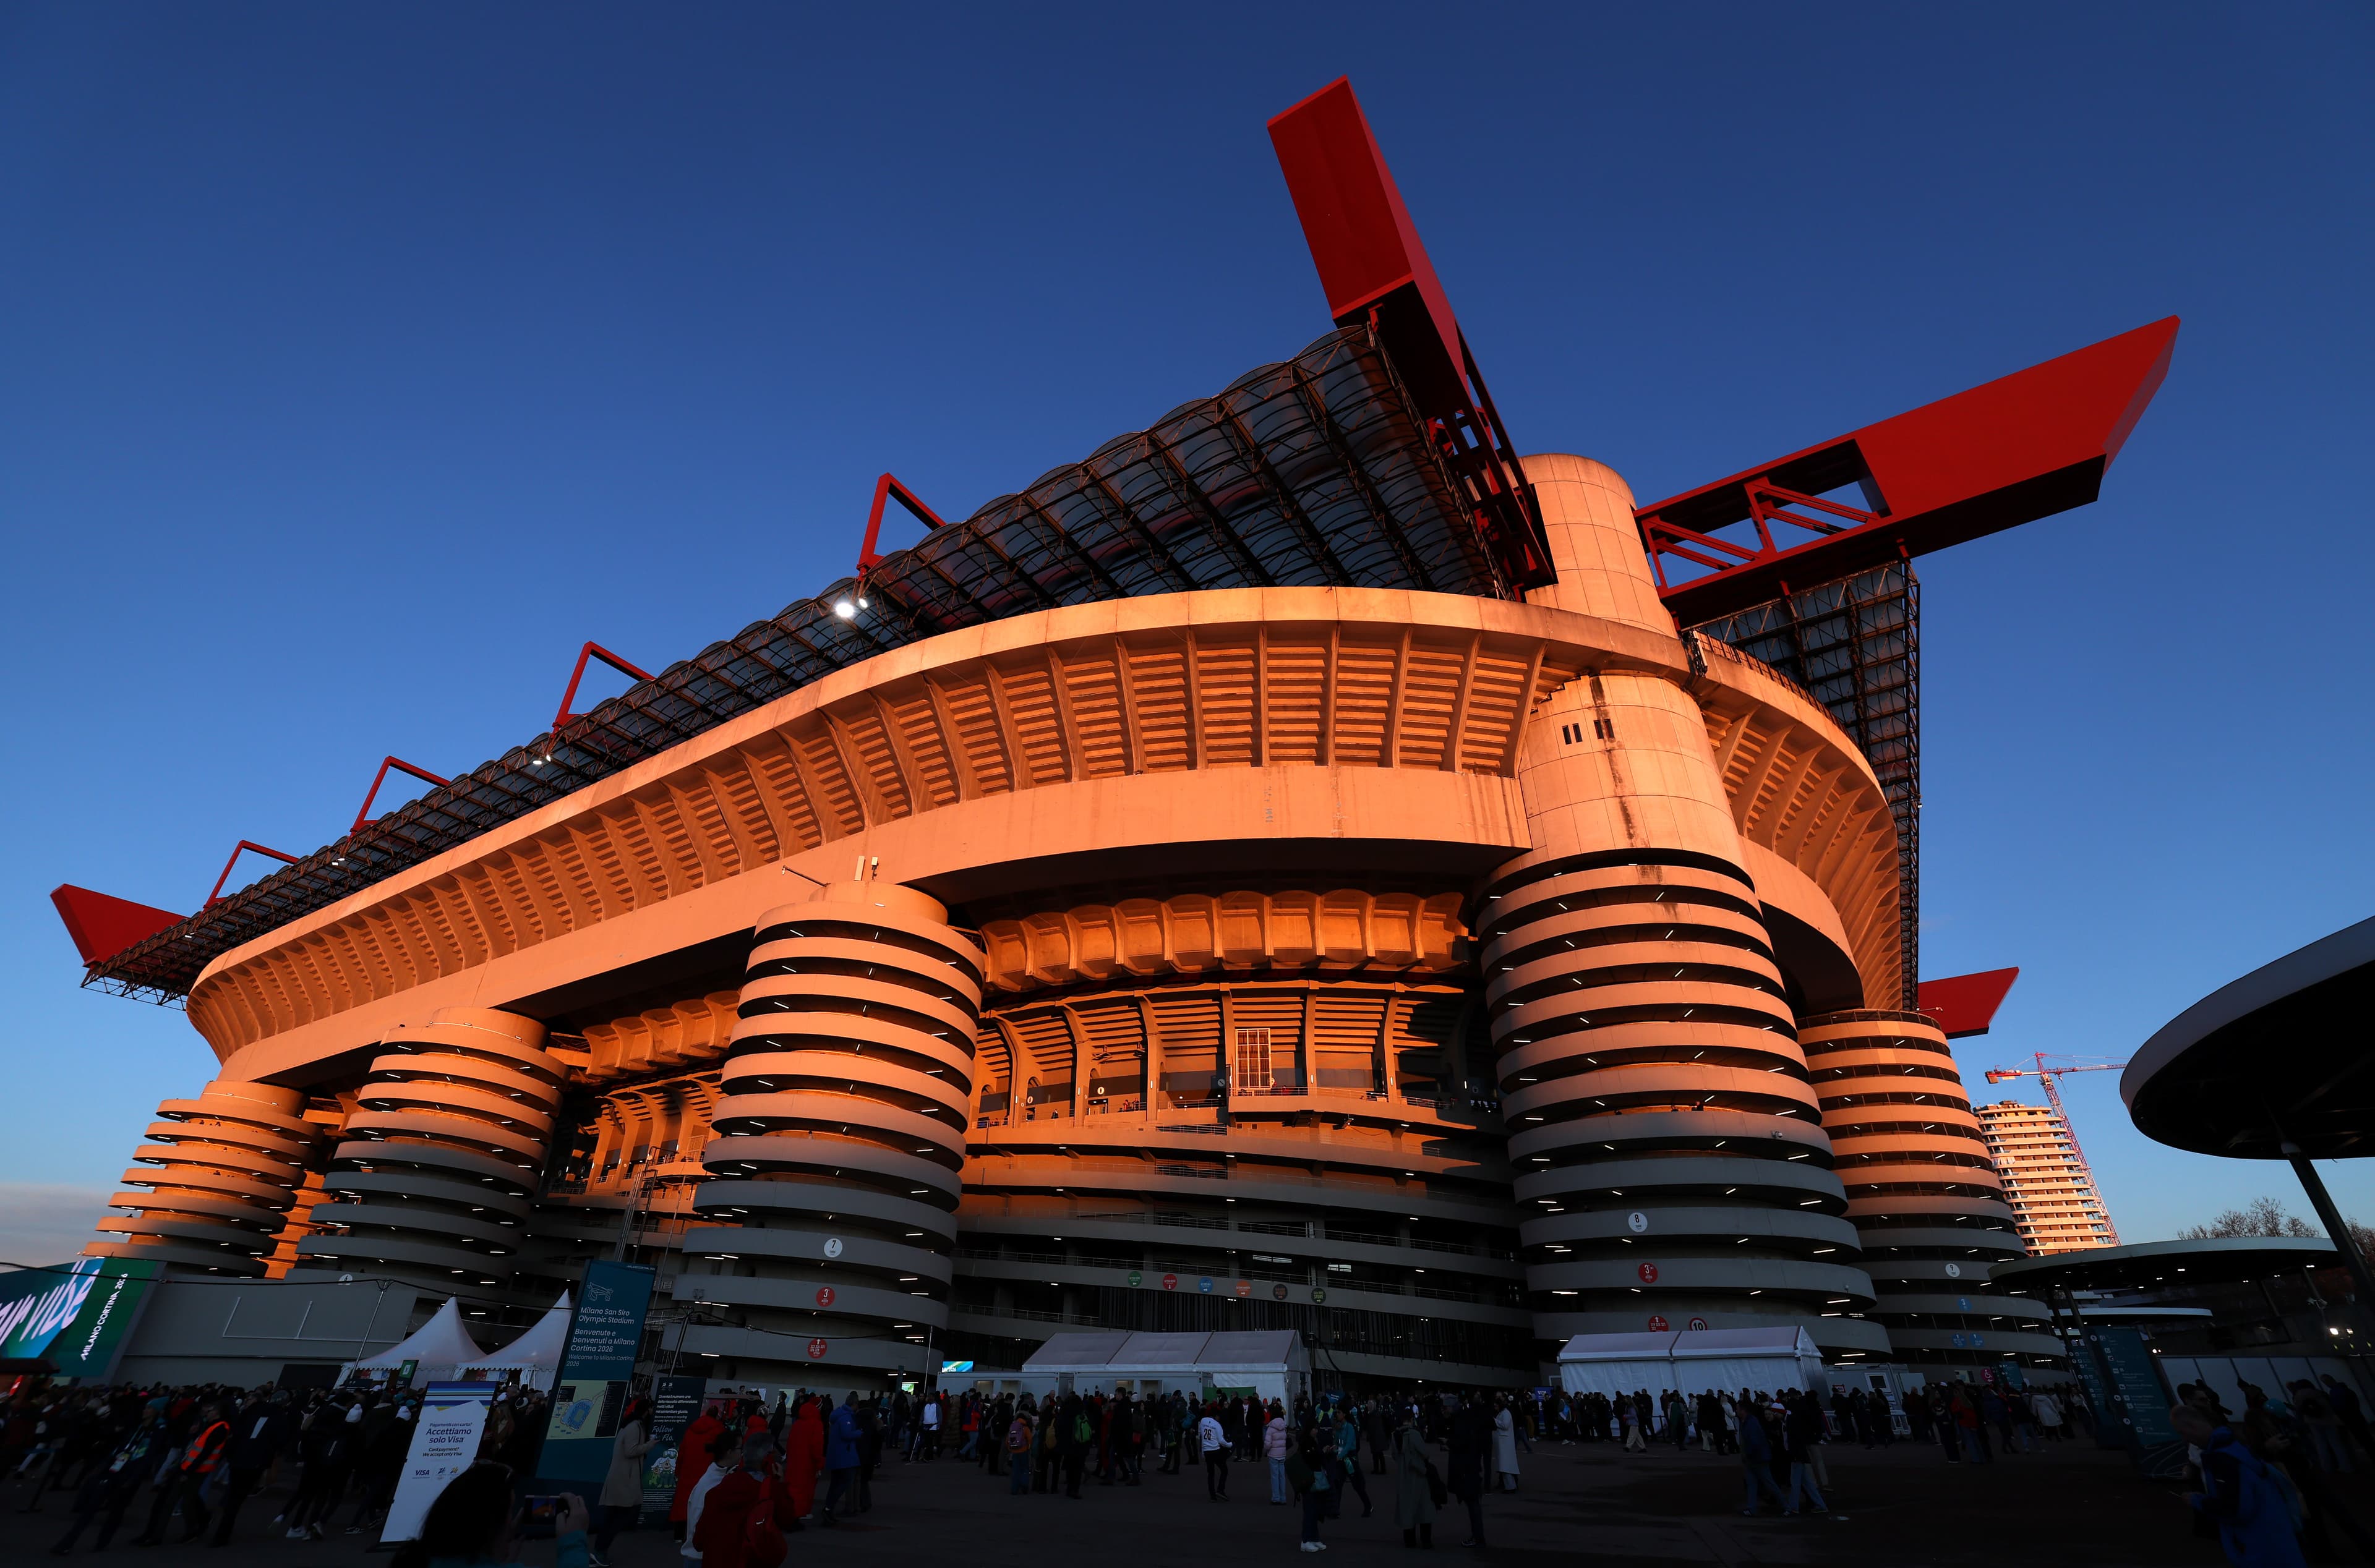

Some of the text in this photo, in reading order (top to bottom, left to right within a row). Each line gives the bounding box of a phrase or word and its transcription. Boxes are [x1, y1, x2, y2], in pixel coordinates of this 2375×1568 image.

[1635, 1214, 1640, 1223] 8
[832, 1240, 837, 1249] 7
[580, 1307, 604, 1315] Milano
[578, 1315, 635, 1324] Olympic Stadium
[80, 1326, 102, 1361] MILANO
[96, 1290, 121, 1326] CORTINA
[1693, 1323, 1703, 1331] 10
[652, 1425, 674, 1433] Follow
[1204, 1428, 1212, 1440] 26
